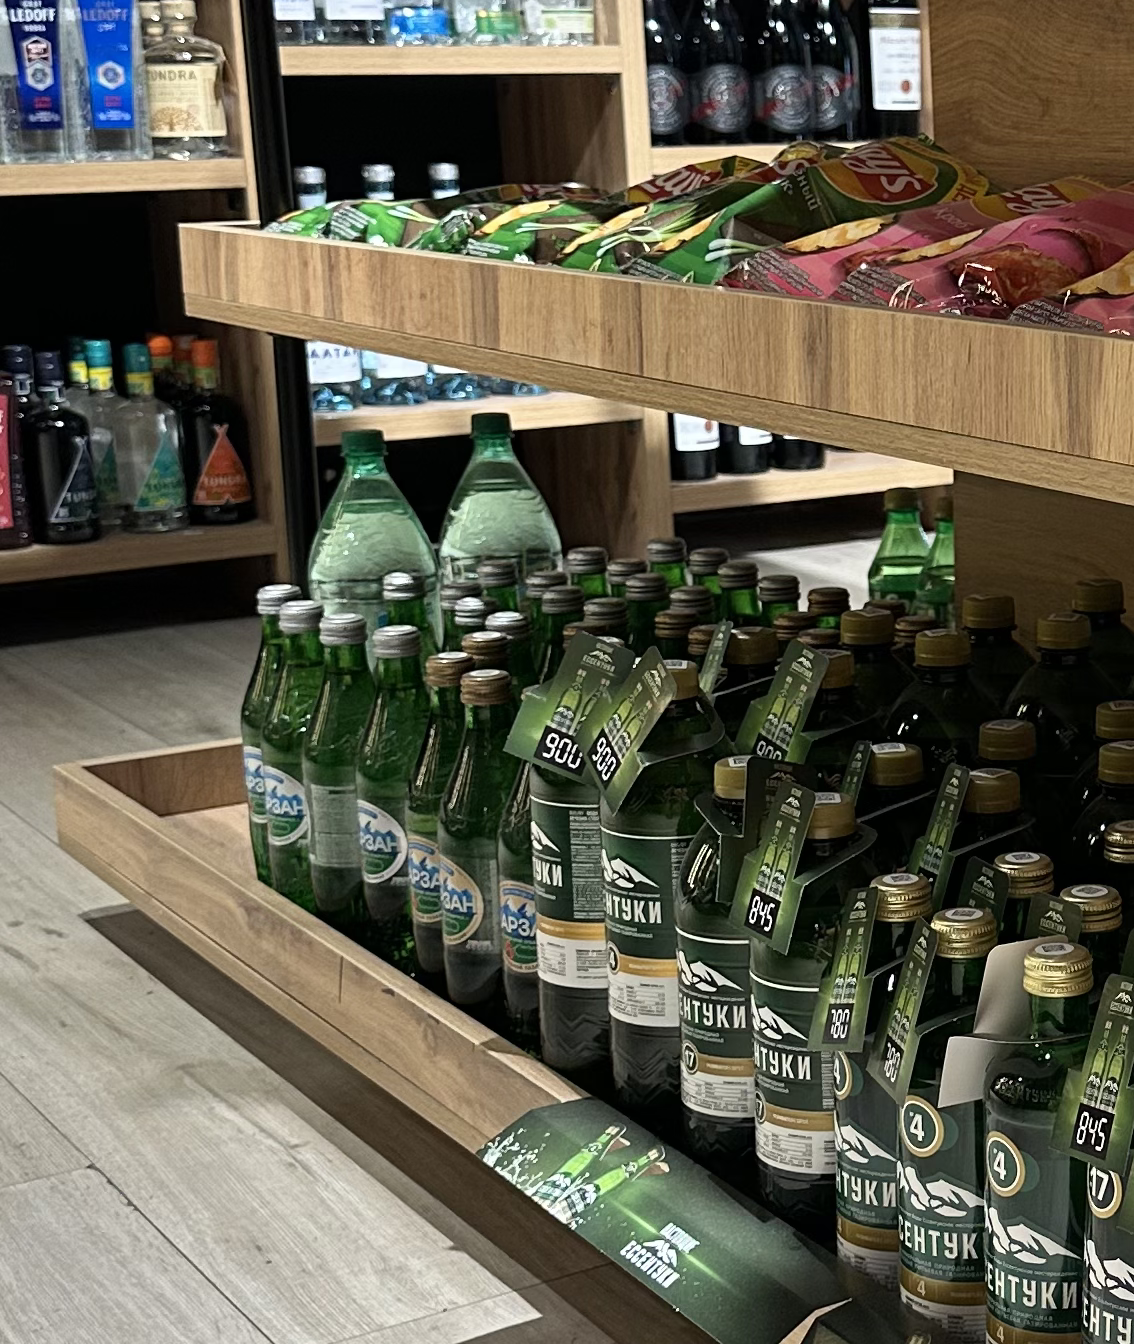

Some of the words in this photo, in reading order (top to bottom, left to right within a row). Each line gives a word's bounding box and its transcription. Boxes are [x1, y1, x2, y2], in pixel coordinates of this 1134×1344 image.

[149, 68, 198, 82] UNDRA
[605, 890, 663, 925] НТУКИ
[748, 894, 774, 933] 845
[679, 992, 748, 1030] ЕНТУКИ
[753, 1041, 812, 1081] НТУКИ
[1076, 1110, 1108, 1152] 845
[836, 1170, 897, 1209] НТУКИ
[986, 1260, 1078, 1310] ЕНТУКИ
